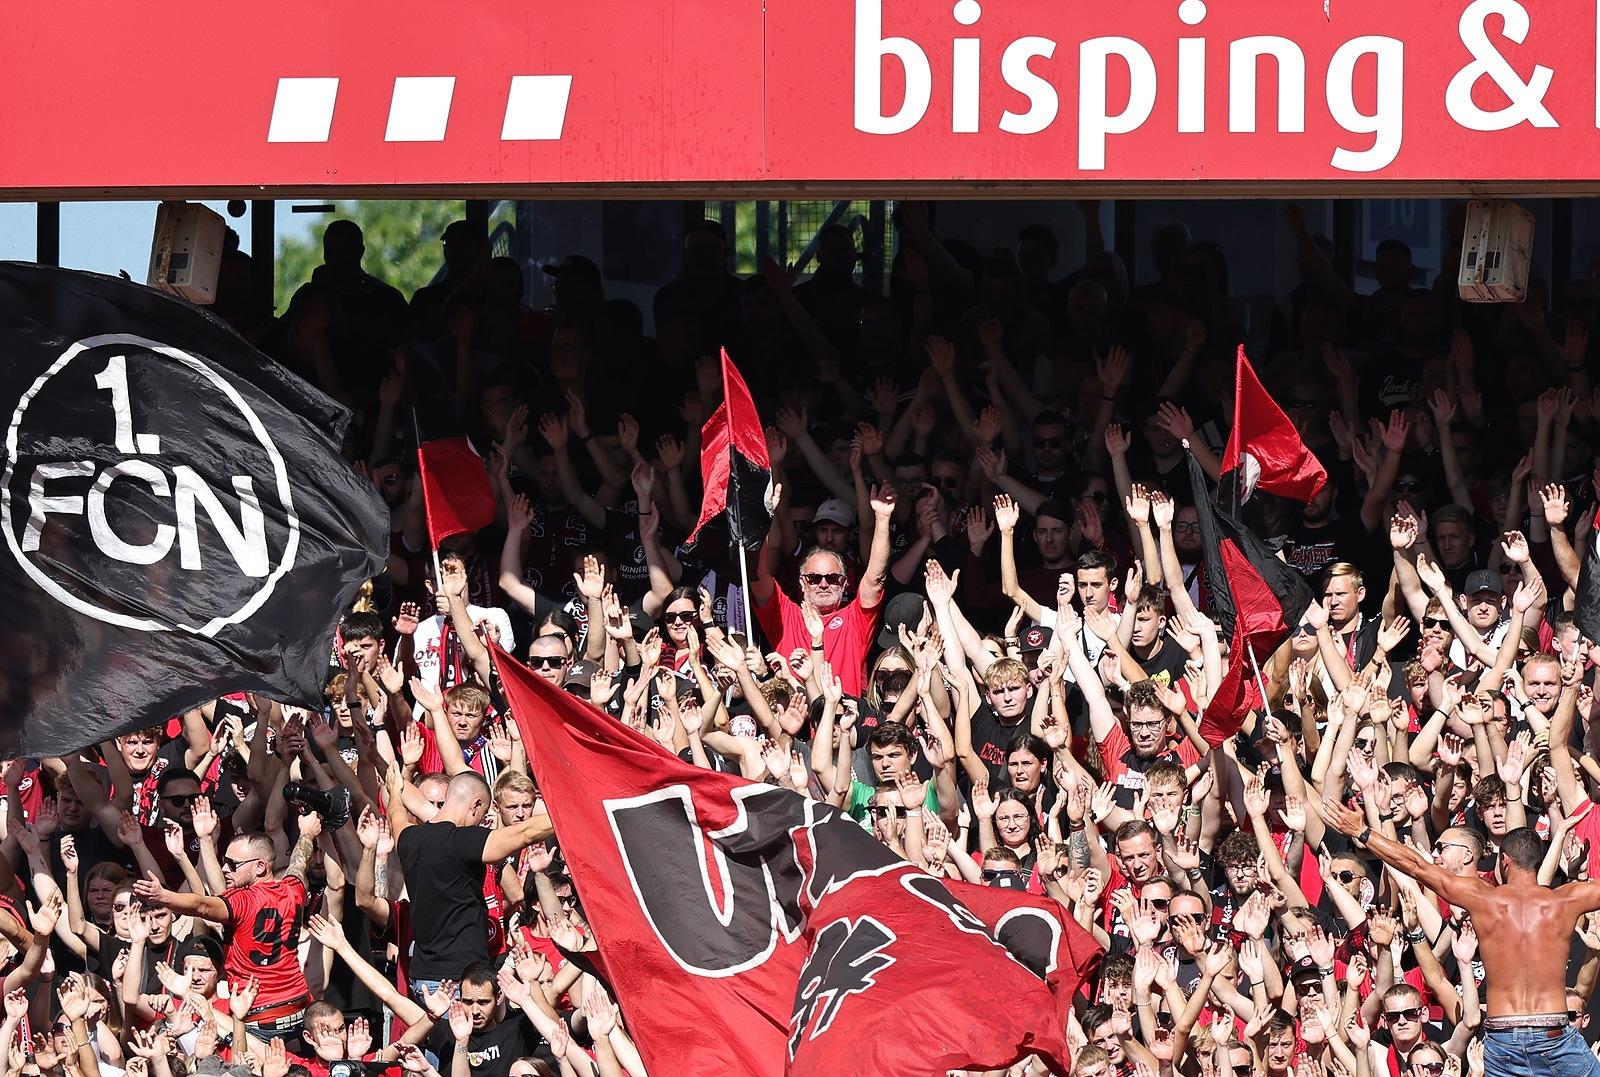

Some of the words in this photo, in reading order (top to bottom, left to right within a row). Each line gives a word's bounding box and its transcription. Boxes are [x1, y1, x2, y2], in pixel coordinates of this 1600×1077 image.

[855, 0, 1405, 172] bisping
[1446, 0, 1559, 131] &
[94, 355, 161, 455] 1.
[23, 460, 270, 578] FCN
